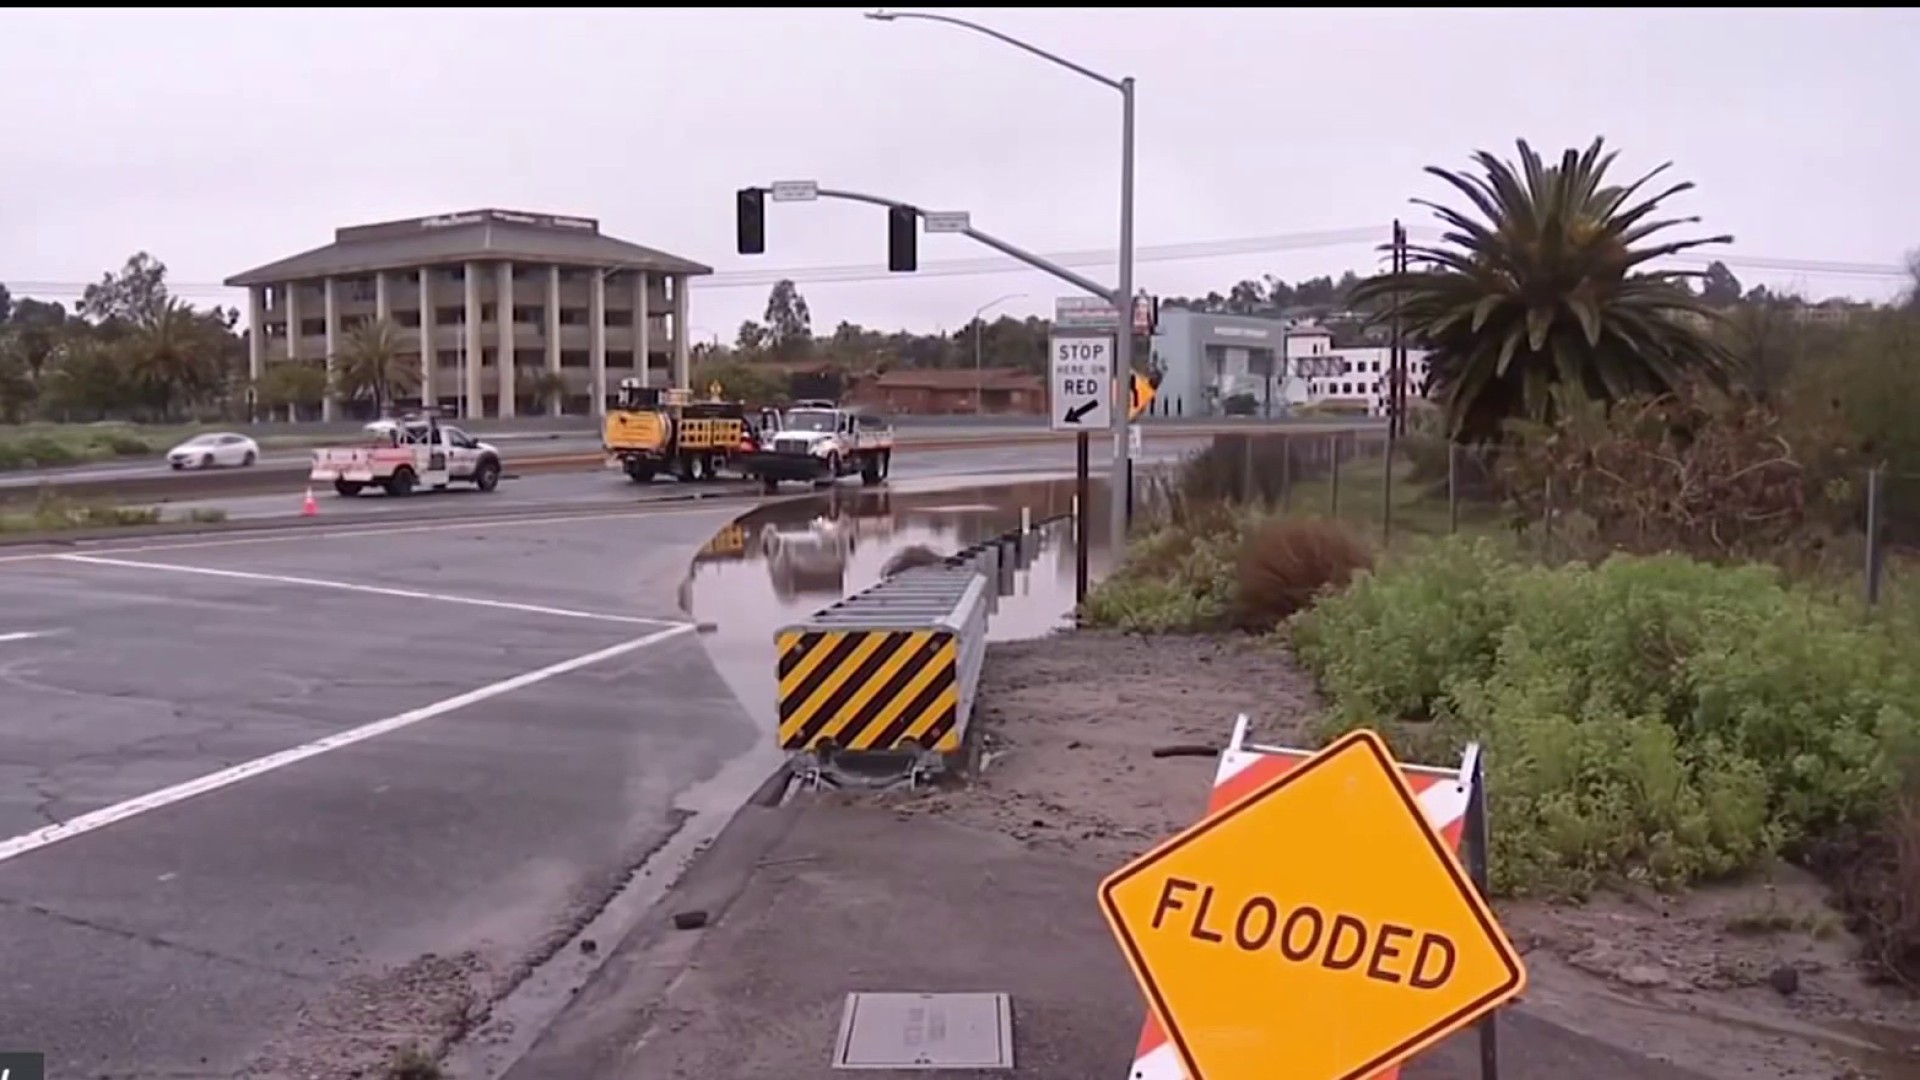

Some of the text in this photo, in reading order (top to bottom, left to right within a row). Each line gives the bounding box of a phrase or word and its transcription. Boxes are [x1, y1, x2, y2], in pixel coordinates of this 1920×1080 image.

[1059, 344, 1104, 360] STOP
[1057, 365, 1084, 375] HERE
[1064, 379, 1098, 395] RED
[1152, 877, 1456, 989] FLOODED
